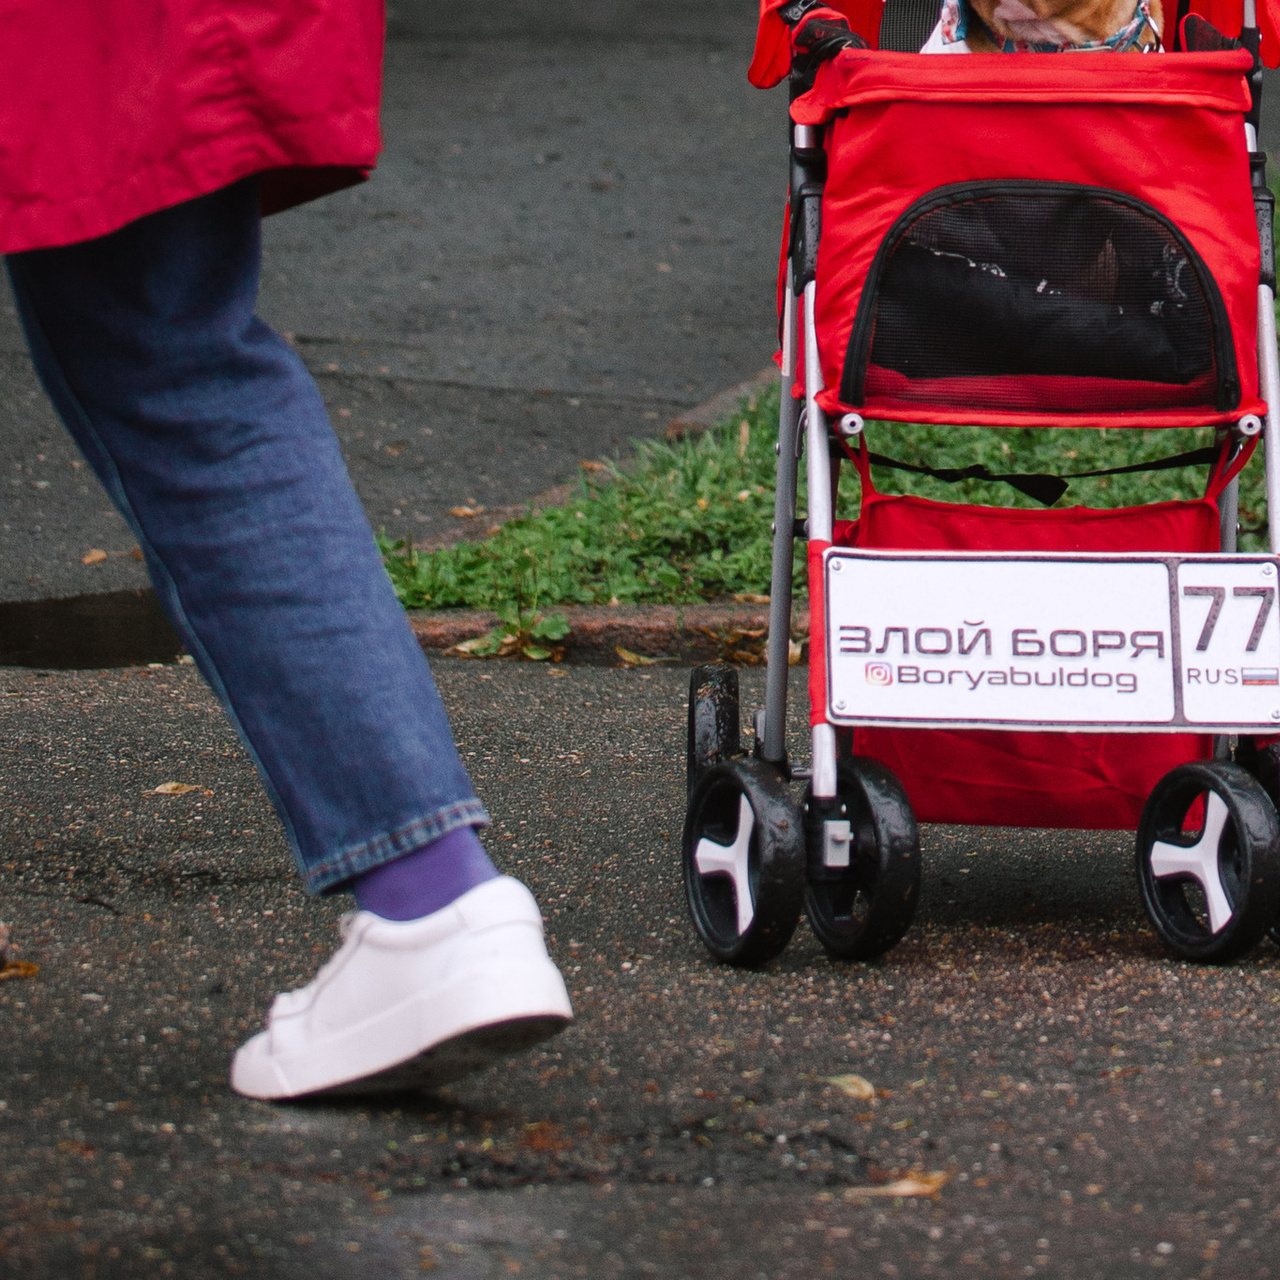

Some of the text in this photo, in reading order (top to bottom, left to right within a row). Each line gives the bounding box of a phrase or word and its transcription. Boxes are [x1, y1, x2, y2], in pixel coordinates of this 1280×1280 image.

[1183, 586, 1275, 652] 77
[839, 620, 1165, 659] ЗЛОЙ БОРЯ
[897, 665, 1138, 693] Boryabuldog
[1187, 667, 1239, 685] RUS
